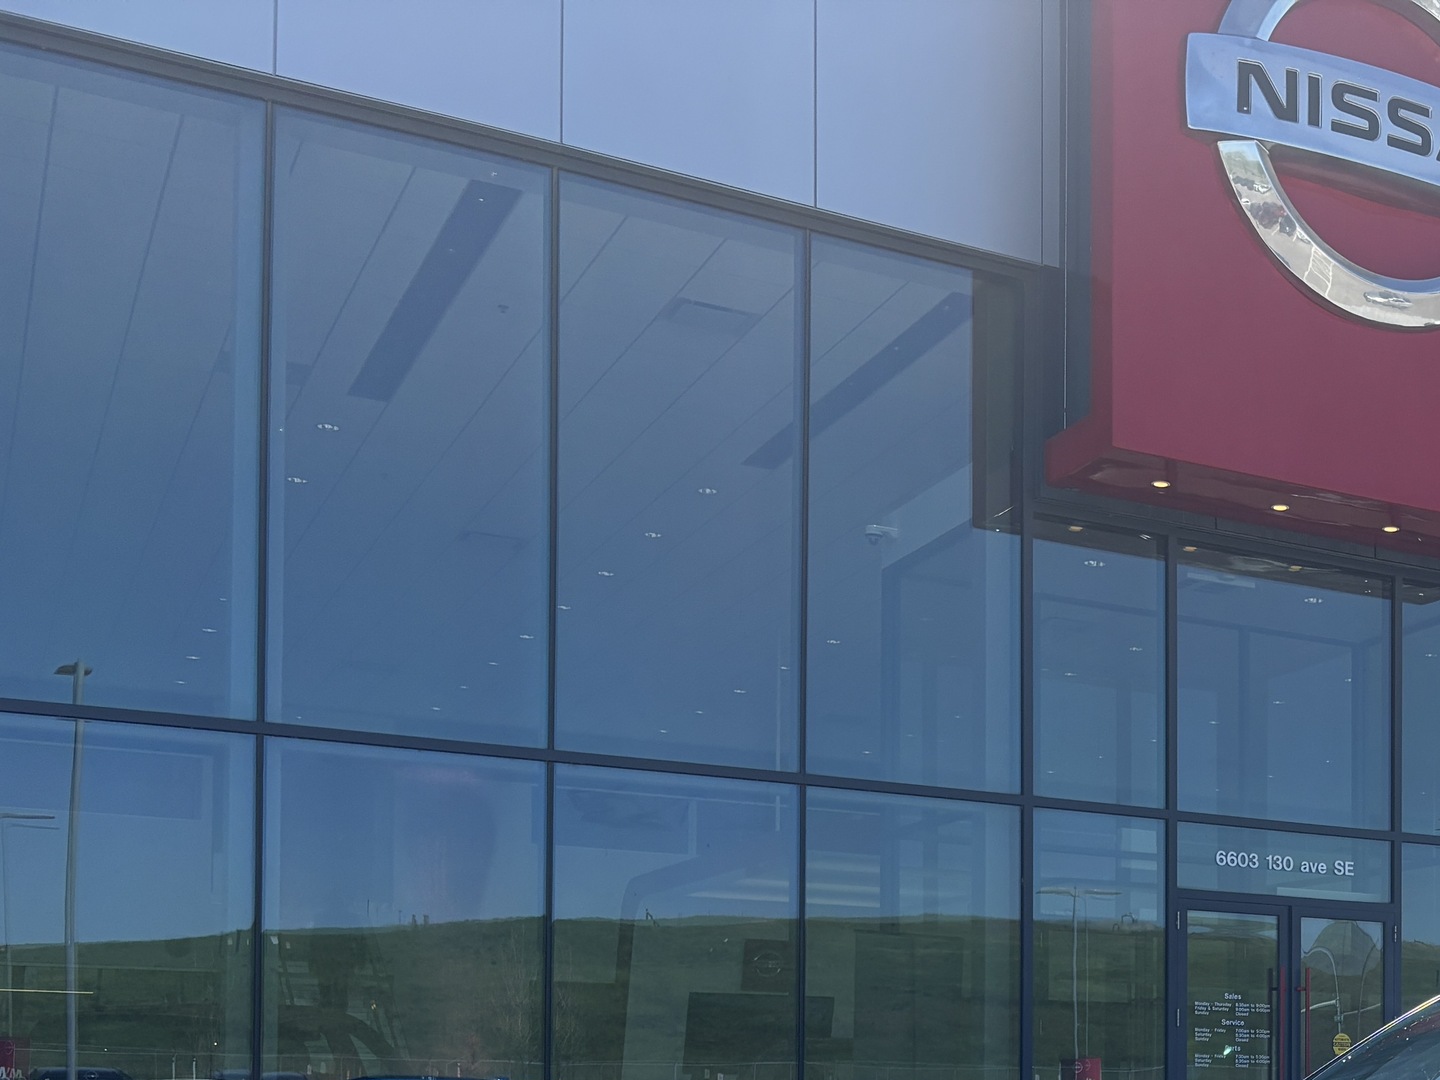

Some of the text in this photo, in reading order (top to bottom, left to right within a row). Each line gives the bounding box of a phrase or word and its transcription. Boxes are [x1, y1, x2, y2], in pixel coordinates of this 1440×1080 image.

[1215, 850, 1355, 876] 6603 130 ave SE
[1224, 992, 1241, 1000] Sales
